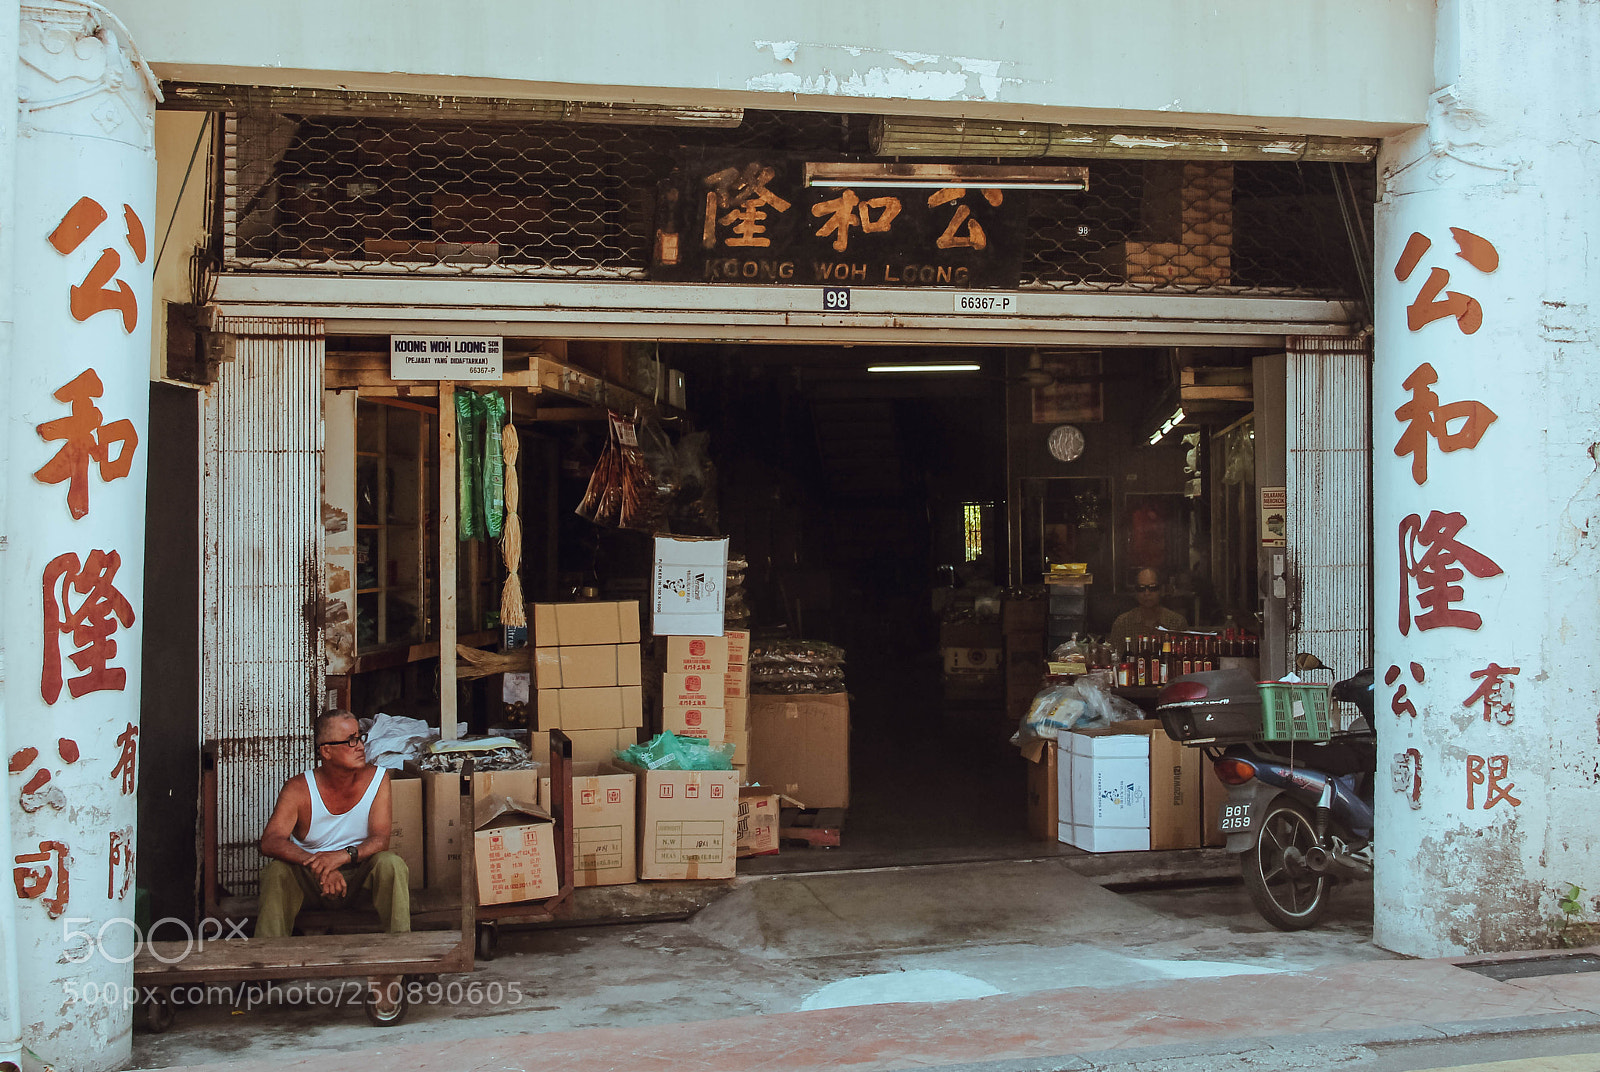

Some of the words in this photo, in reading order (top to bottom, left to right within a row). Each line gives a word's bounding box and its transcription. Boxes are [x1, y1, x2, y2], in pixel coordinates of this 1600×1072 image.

[1078, 226, 1088, 235] 98
[705, 258, 795, 278] KOONG
[815, 263, 868, 281] WOH
[884, 264, 969, 284] LOONG
[826, 290, 848, 308] 98
[960, 295, 1011, 310] 66367-P
[395, 340, 427, 353] KOONG
[430, 340, 451, 353] WOH
[455, 341, 486, 354] LOONG
[405, 356, 431, 364] (PEJABAT
[450, 357, 488, 365] DIDAFTARKAN)
[1394, 226, 1504, 637] 公和隆
[33, 196, 147, 706] 公和隆
[1225, 805, 1250, 817] BGT
[1221, 817, 1251, 829] 2159
